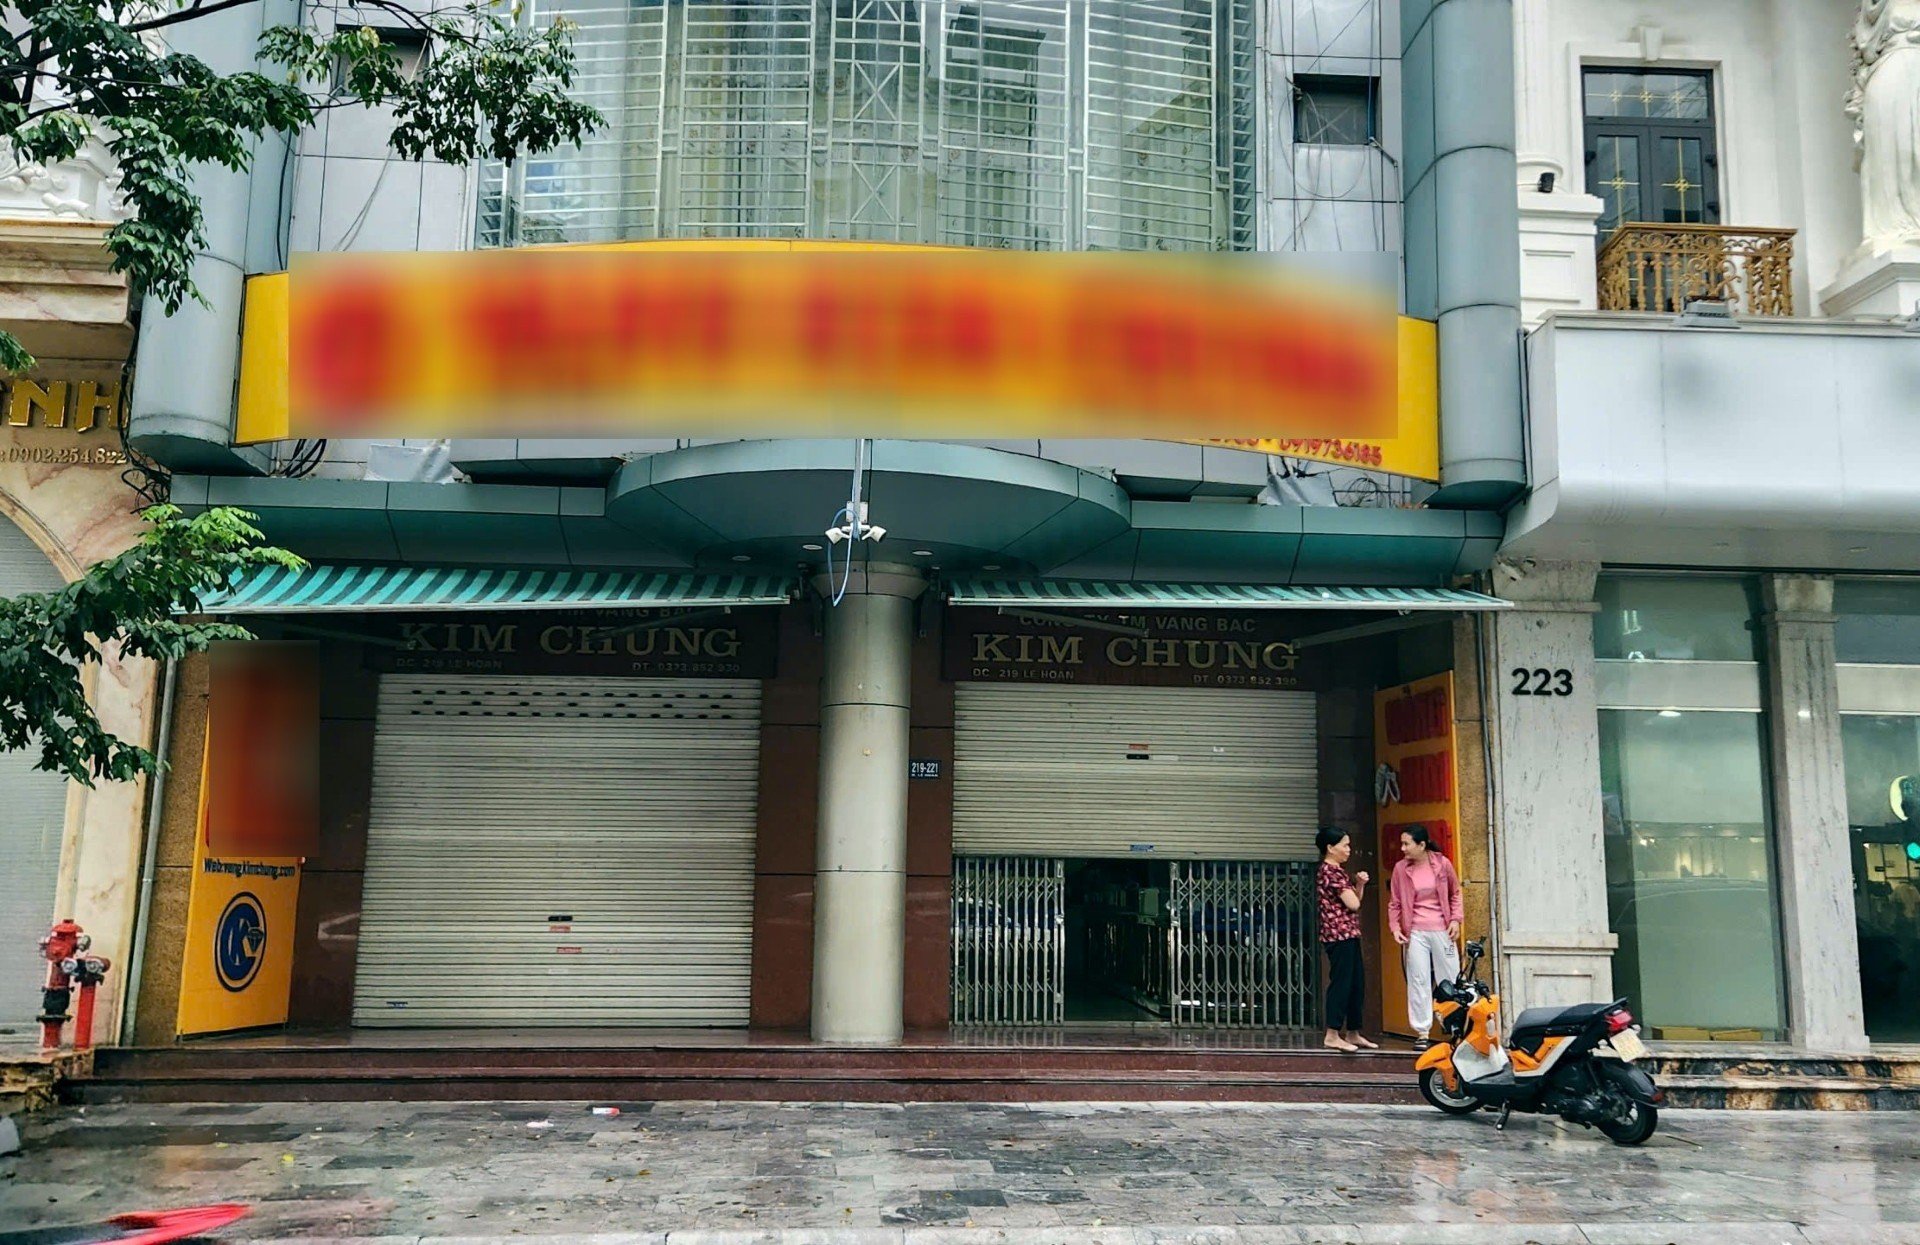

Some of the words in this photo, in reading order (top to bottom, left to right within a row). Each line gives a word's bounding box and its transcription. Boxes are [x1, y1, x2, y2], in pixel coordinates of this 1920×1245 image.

[0, 379, 128, 433] NH
[1155, 616, 1208, 631] VANG
[395, 622, 518, 653] KIM
[540, 625, 742, 658] CHUNG
[972, 634, 1084, 664] KIM
[1106, 637, 1300, 671] CHUNG
[999, 669, 1019, 678] 219
[1511, 667, 1573, 696] 223
[911, 762, 938, 773] 219-221
